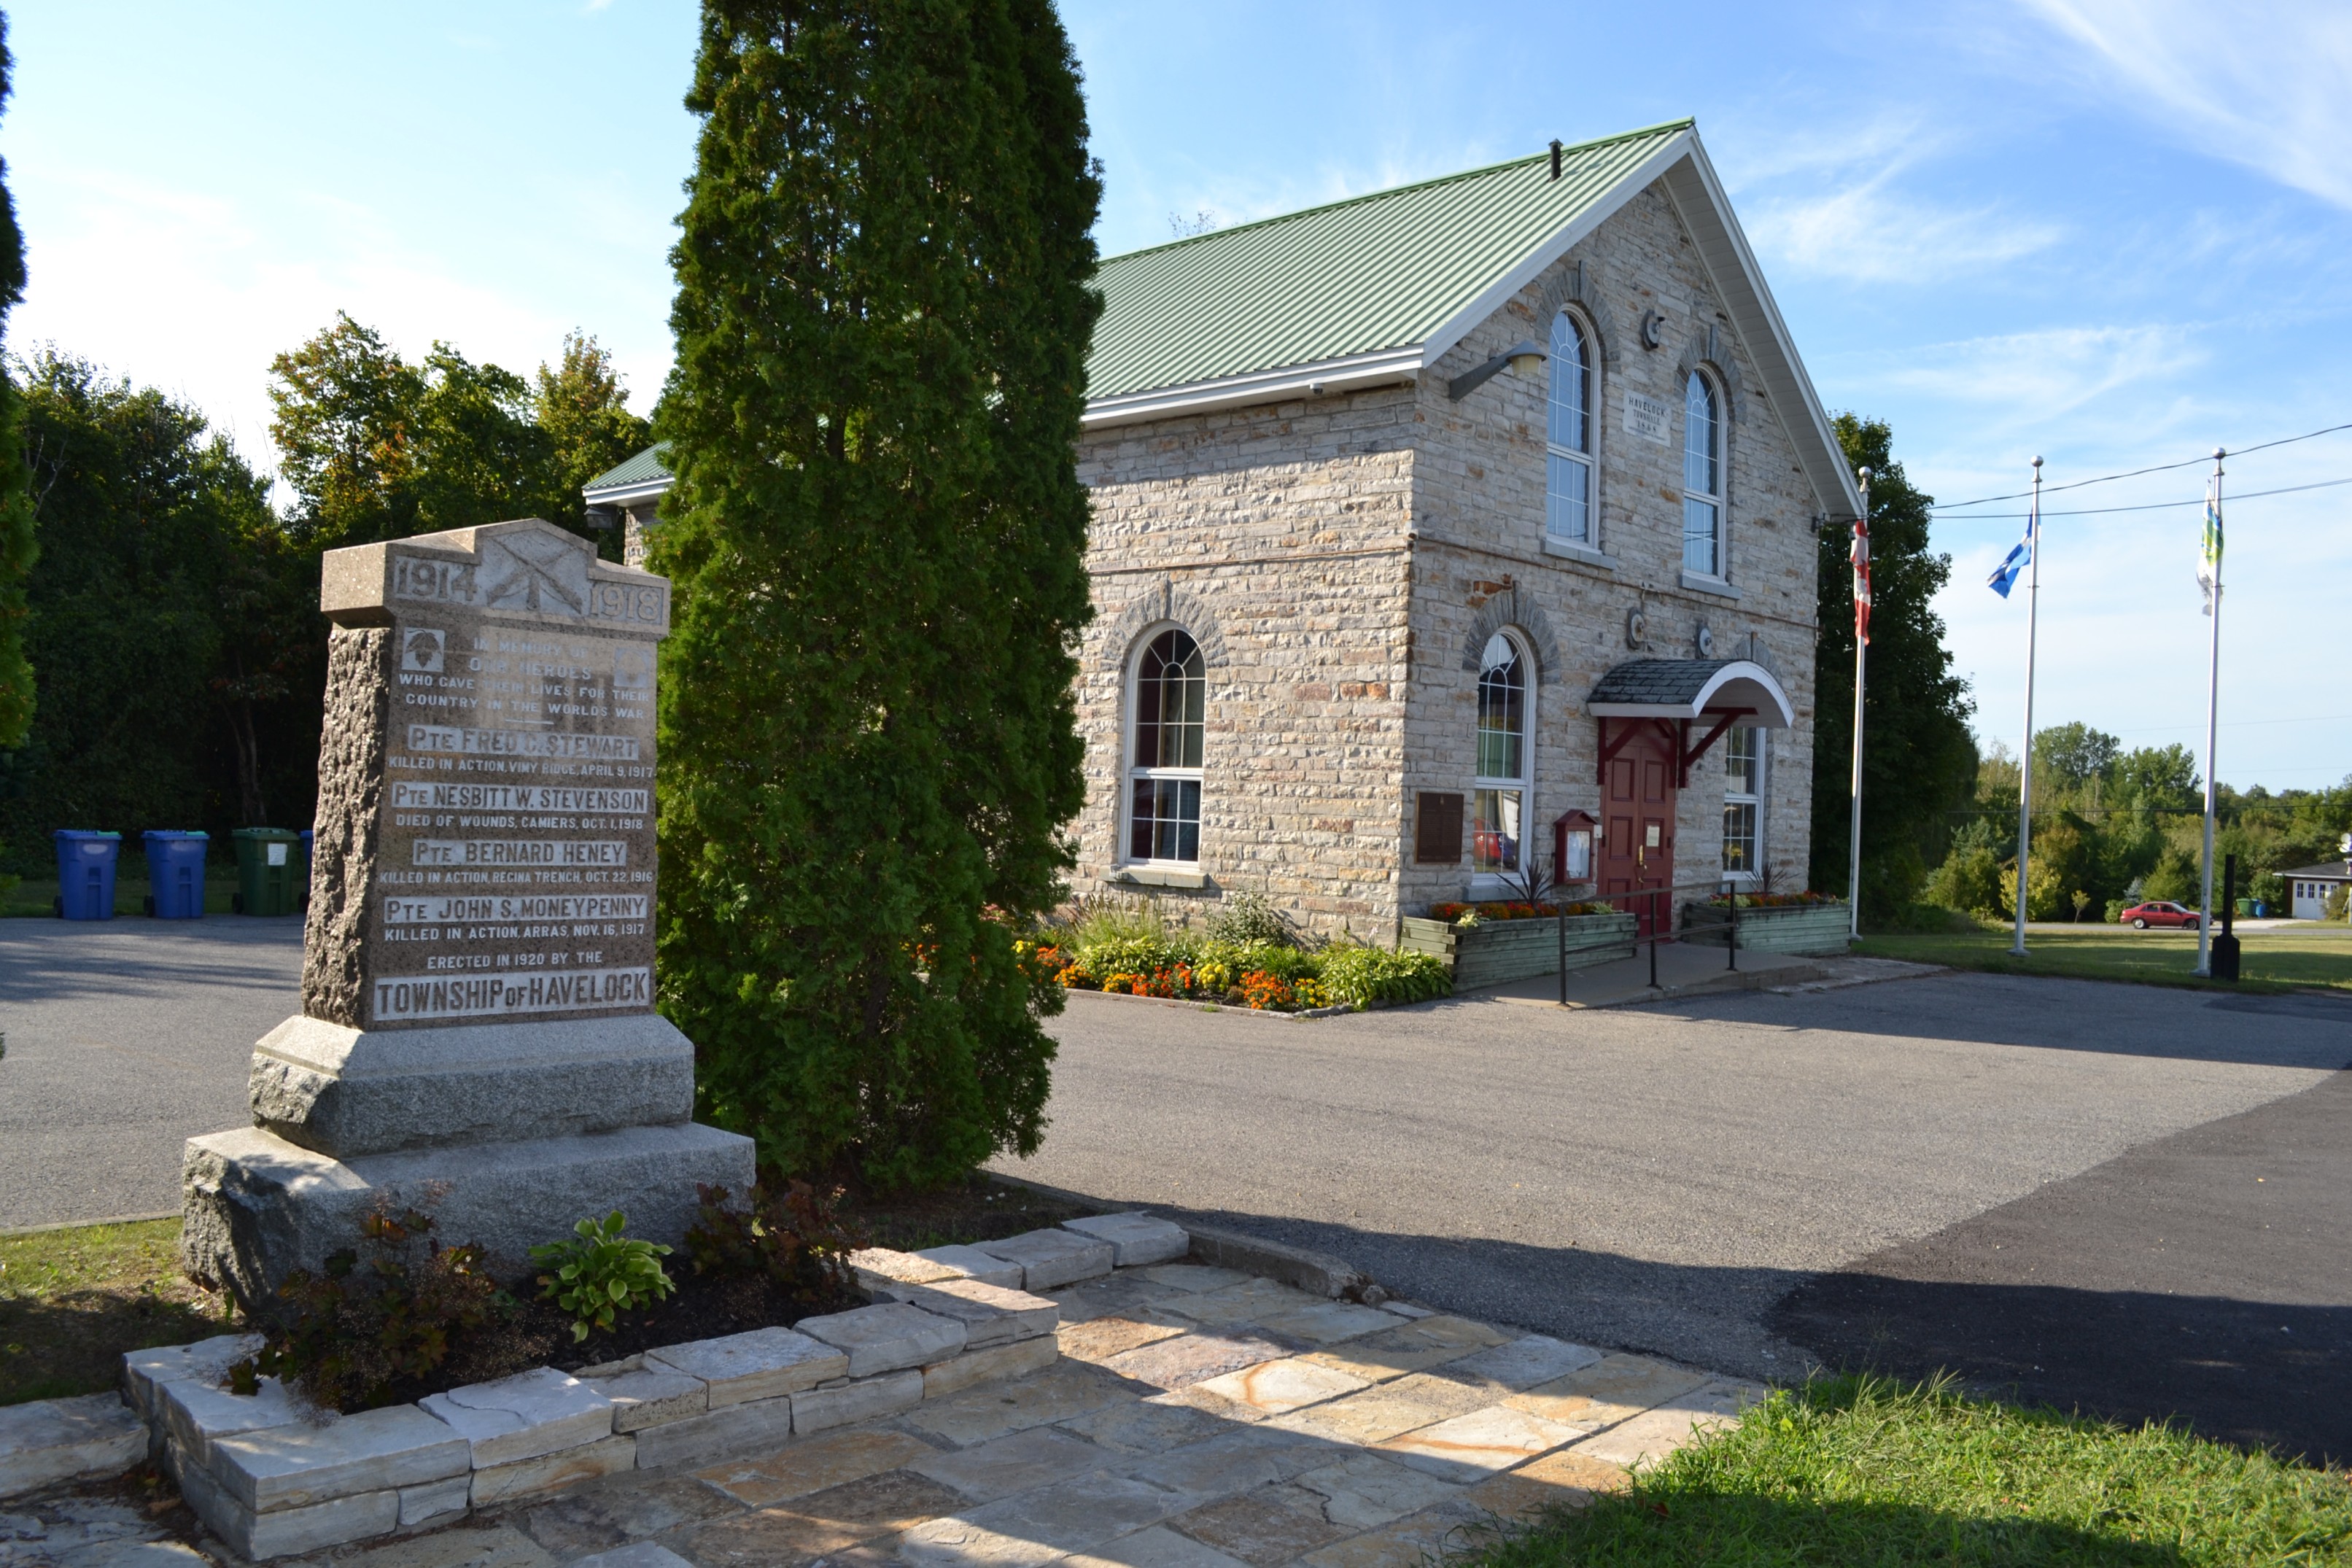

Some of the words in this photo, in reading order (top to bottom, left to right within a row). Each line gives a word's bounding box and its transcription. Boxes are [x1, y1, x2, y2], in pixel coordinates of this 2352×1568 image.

[1629, 396, 1666, 418] HAVELOCK
[396, 561, 477, 602] 1914
[589, 583, 659, 620] 1918
[474, 637, 489, 650] IN
[499, 640, 562, 656] MEMORY
[571, 647, 589, 658] OF
[470, 658, 507, 672] OUR
[520, 661, 591, 680] HEROES
[399, 674, 432, 686] WHO
[439, 677, 475, 689] GAVE
[483, 680, 524, 692] THEIR
[531, 684, 572, 696] LIVES
[579, 688, 605, 699] FOR
[613, 690, 649, 702] THEIR
[405, 694, 478, 707] COUNTRY
[487, 699, 502, 710] IN
[511, 701, 538, 712] THE
[548, 704, 608, 716] WORLDS
[616, 707, 644, 719] WAR
[462, 730, 518, 752] FRED
[547, 735, 637, 758] STEWART
[389, 756, 435, 769] KILLED
[440, 758, 452, 769] IN
[459, 759, 508, 773] ACTION,
[509, 761, 538, 773] VIMY
[542, 764, 580, 776] RIDGE,
[581, 764, 614, 776] APRIL
[628, 766, 654, 778] 1917
[434, 785, 511, 807] NESBITT
[516, 788, 534, 808] W.
[540, 788, 645, 811] STEVENSON
[396, 814, 430, 826] DIED
[436, 815, 454, 826] OF
[460, 815, 517, 828] WOUNDS,
[521, 817, 578, 830] CAMIERS,
[582, 818, 607, 829] OCT.
[619, 819, 643, 830] 1918
[465, 842, 554, 863] BERNARD
[563, 844, 624, 863] HENEY
[380, 872, 423, 883] KILLED
[428, 872, 440, 882] IN
[445, 872, 490, 884] ACTION,
[492, 872, 531, 883] REGINA
[535, 872, 582, 884] TRENCH,
[586, 872, 609, 882] OCT.
[631, 872, 653, 882] 1916
[439, 899, 493, 919] JOHN
[500, 899, 517, 918] S.
[521, 898, 645, 917] MONEYPENNY
[385, 928, 439, 941] KILLED
[447, 928, 461, 939] IN
[469, 926, 521, 939] ACTION,
[523, 925, 570, 938] ARRAS,
[573, 924, 599, 936] NOV.
[603, 924, 618, 936] 16,
[621, 923, 645, 935] 1917
[427, 955, 491, 969] ERECTED
[497, 954, 509, 966] IN
[515, 953, 545, 966] 1920
[551, 952, 569, 964] BY
[577, 951, 602, 963] THE
[377, 979, 503, 1014] TOWNSHIP
[529, 973, 647, 1006] HAVELOCK
